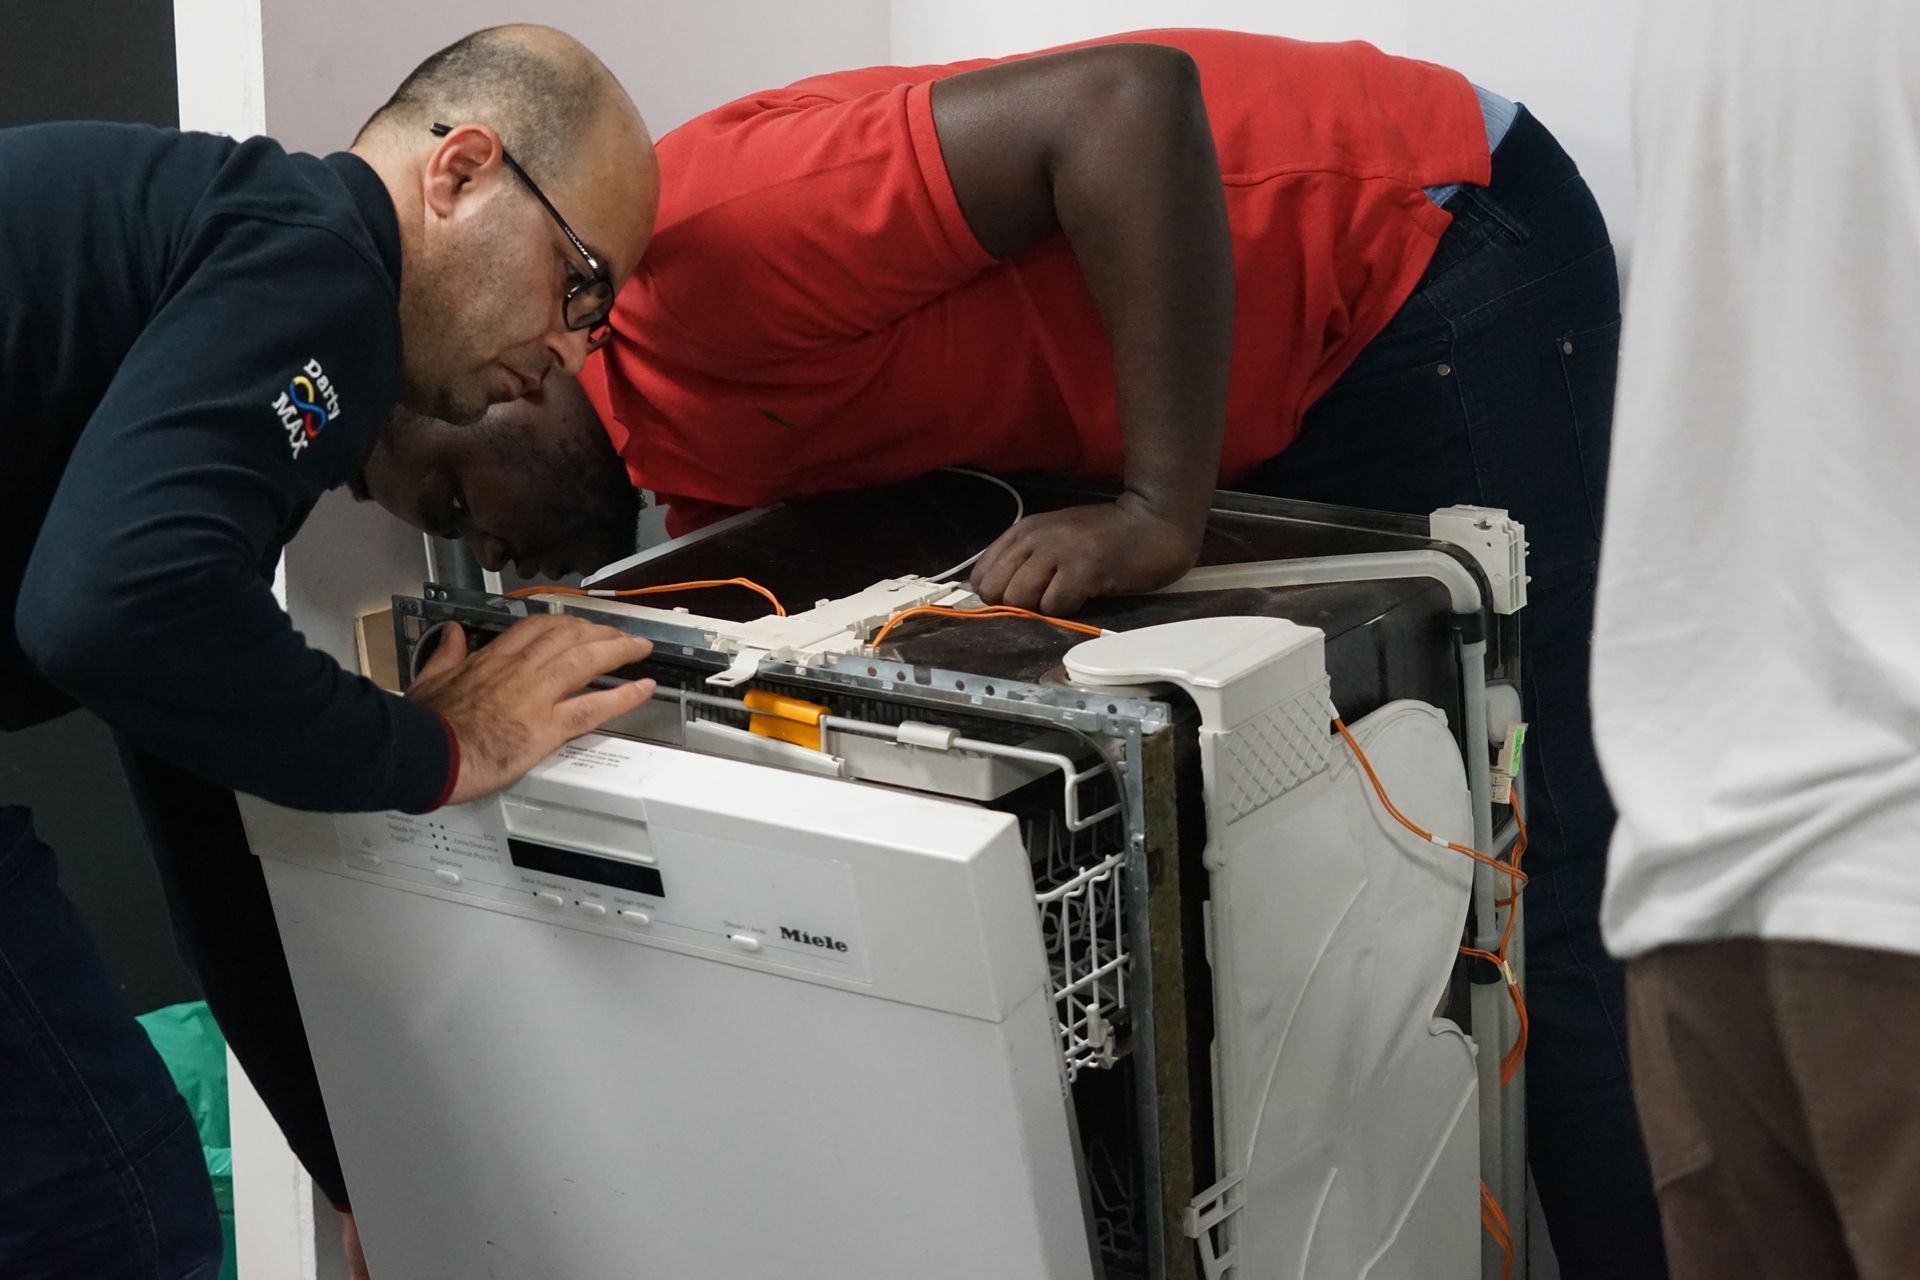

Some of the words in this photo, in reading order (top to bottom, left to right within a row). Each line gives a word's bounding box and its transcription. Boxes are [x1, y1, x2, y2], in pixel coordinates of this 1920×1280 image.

[303, 358, 341, 421] Darty
[271, 391, 309, 460] MAX
[779, 926, 848, 953] Miele
